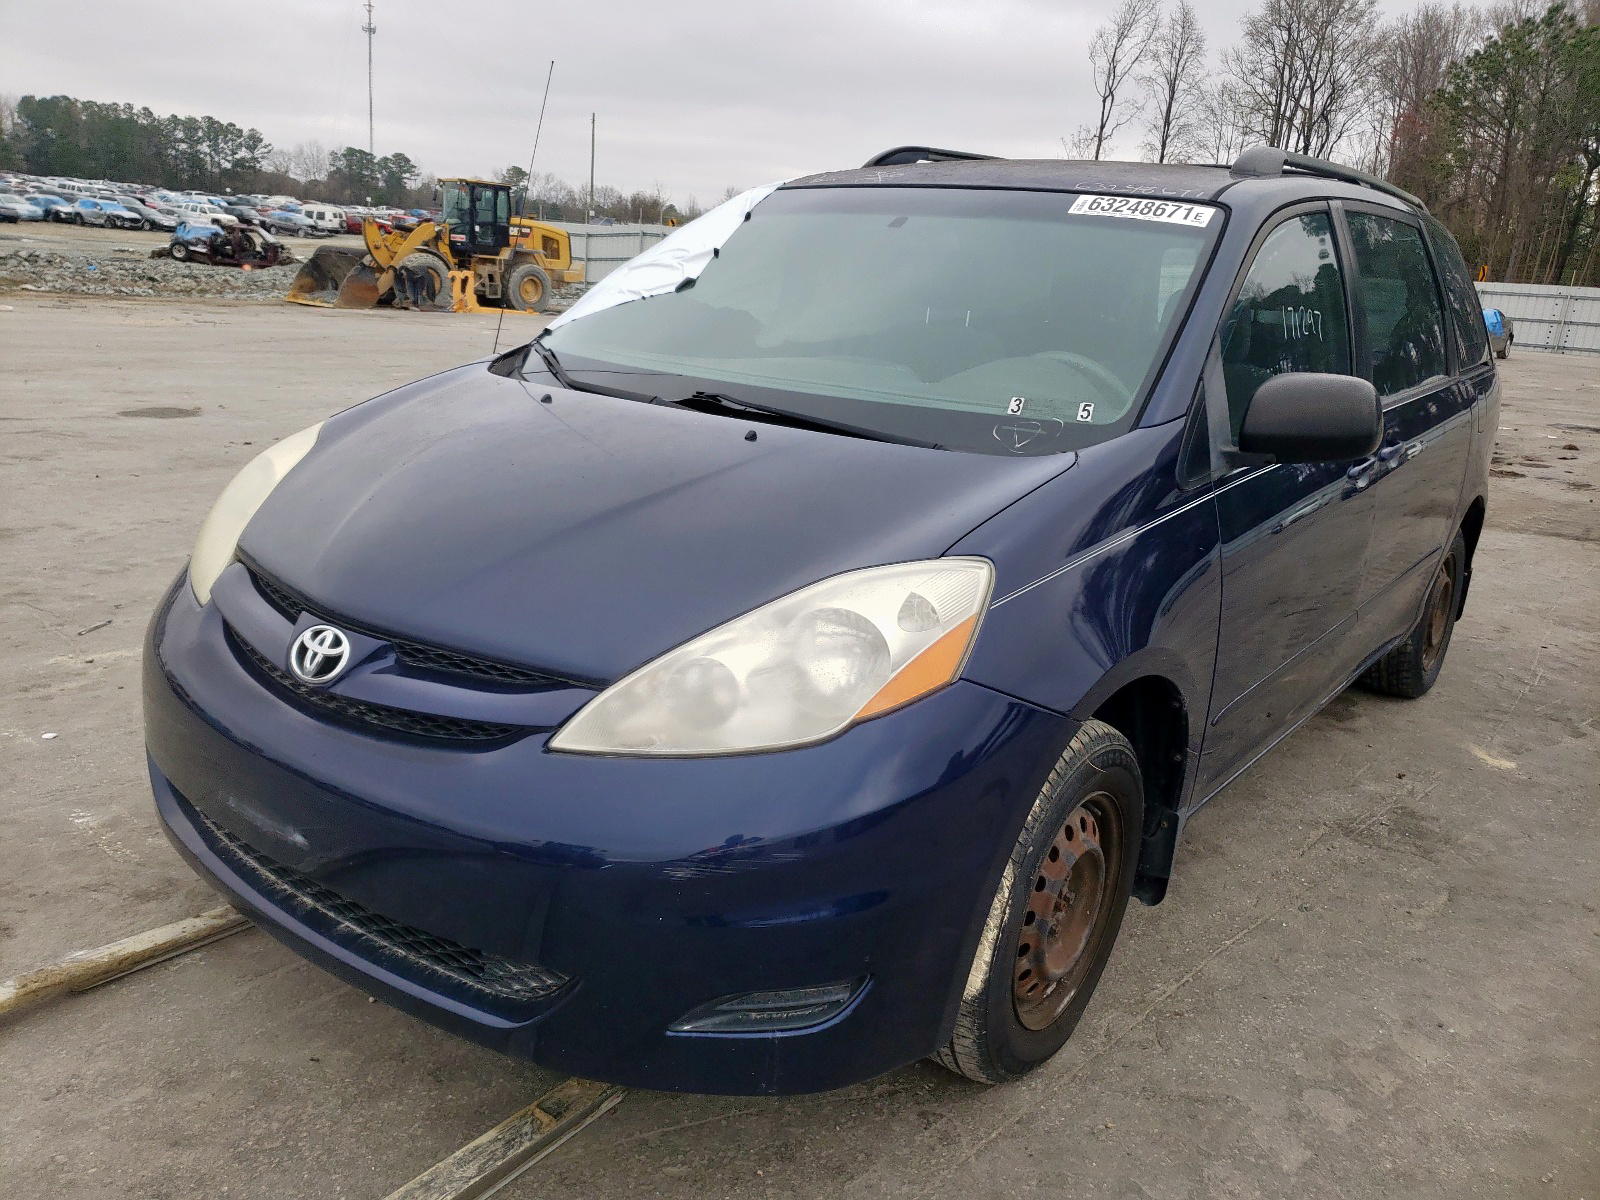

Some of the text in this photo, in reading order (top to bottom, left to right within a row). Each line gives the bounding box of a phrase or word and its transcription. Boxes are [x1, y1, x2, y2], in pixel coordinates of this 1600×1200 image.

[1088, 197, 1195, 221] 63248671
[1194, 212, 1205, 221] E
[1011, 398, 1023, 414] 3
[1080, 403, 1092, 420] 5
